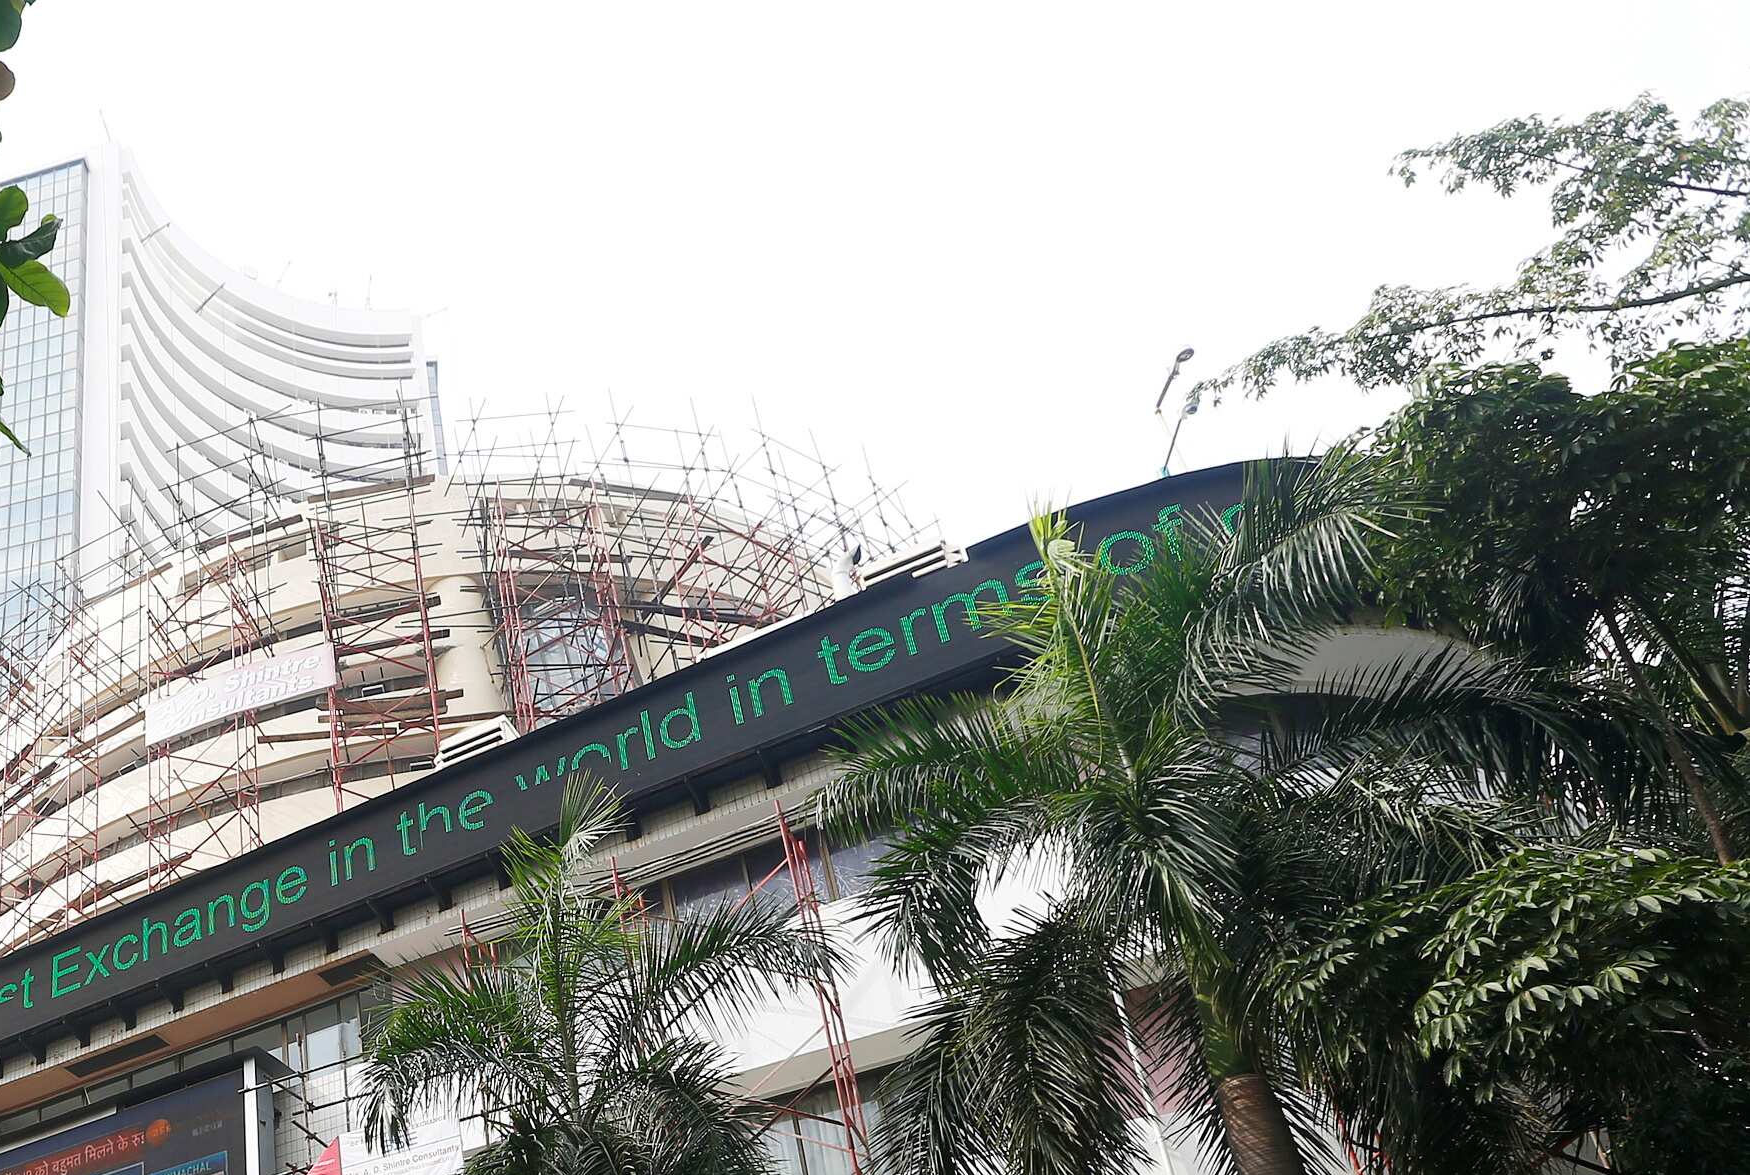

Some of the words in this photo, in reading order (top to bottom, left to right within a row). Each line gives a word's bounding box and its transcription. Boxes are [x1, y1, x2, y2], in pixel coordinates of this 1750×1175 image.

[51, 865, 308, 998] Exchange
[328, 837, 377, 885] in
[396, 789, 494, 857] the
[726, 668, 795, 725] in
[1100, 503, 1183, 576] of
